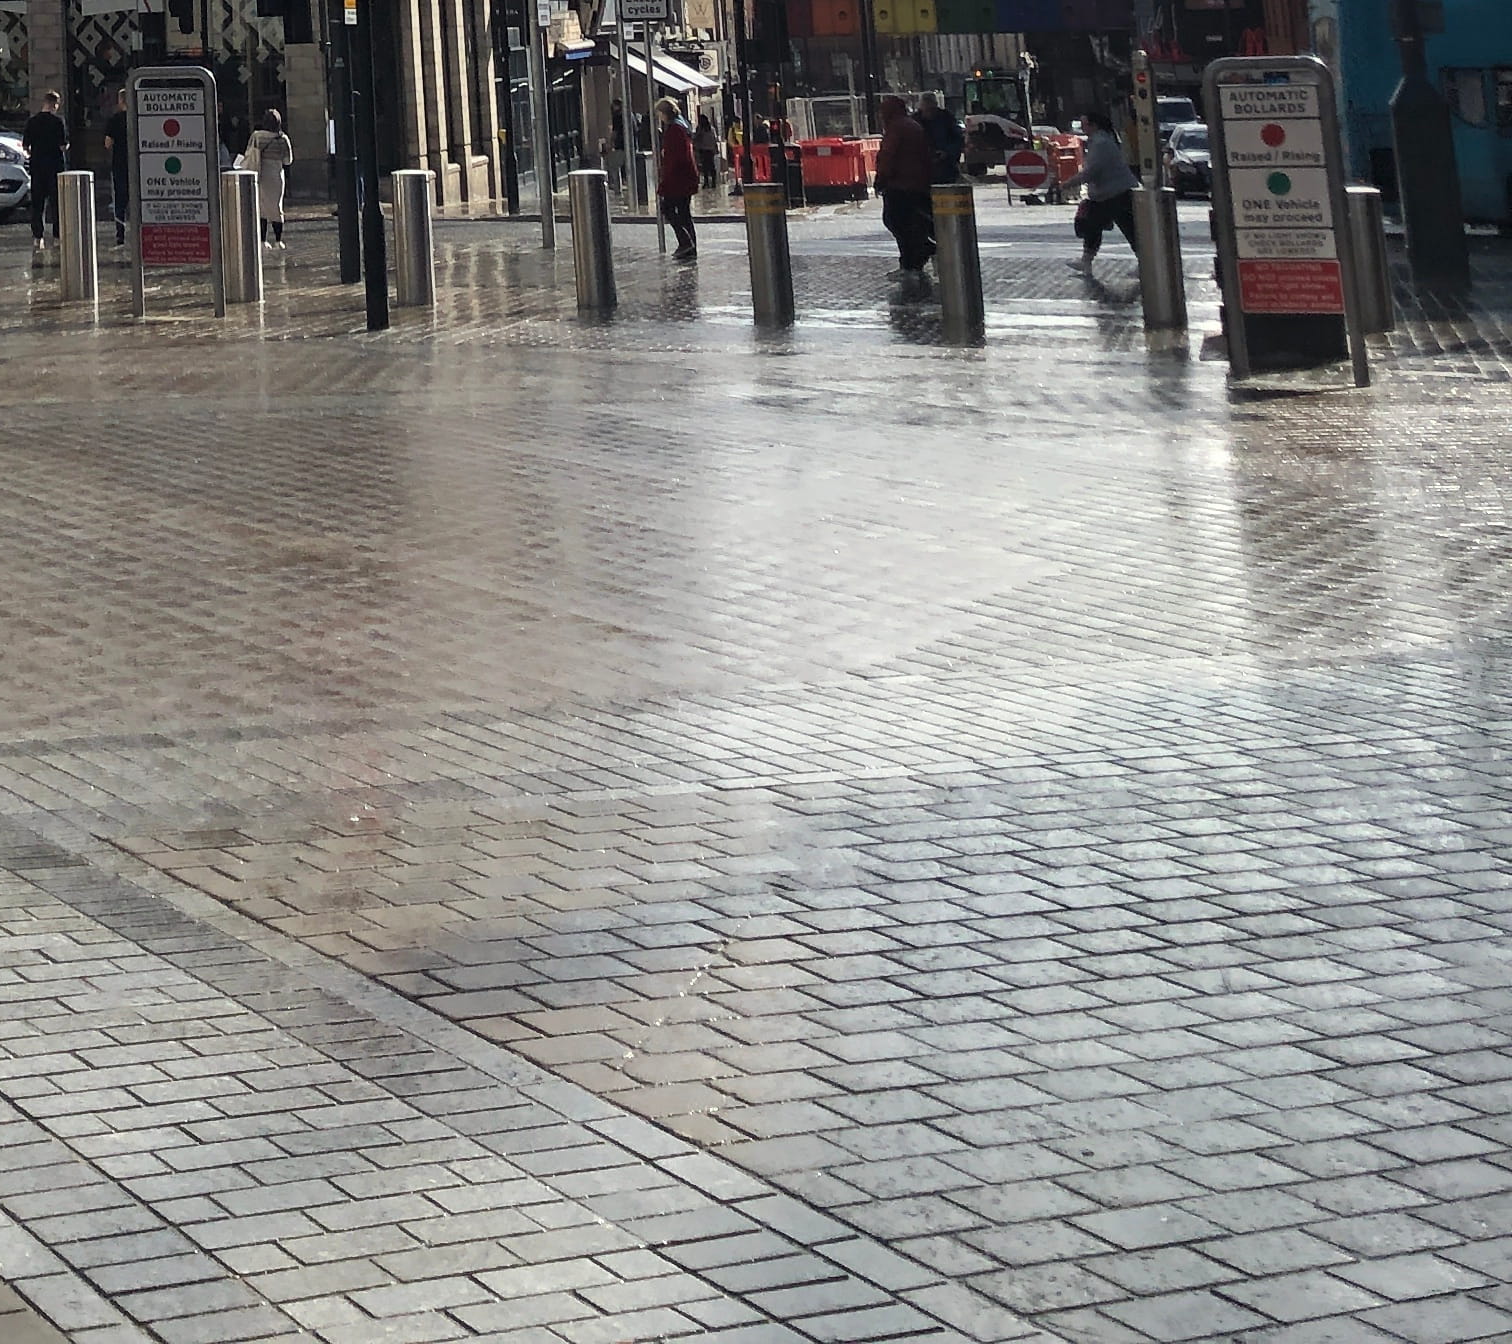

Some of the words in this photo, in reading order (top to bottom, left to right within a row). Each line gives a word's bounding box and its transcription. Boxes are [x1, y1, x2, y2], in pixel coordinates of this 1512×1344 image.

[628, 5, 661, 16] cycles
[143, 93, 197, 102] AUTOMATIC
[1229, 90, 1309, 102] AUTOMATIC
[146, 103, 195, 112] BOLLARDS
[1234, 102, 1306, 114] BOLLARDS
[141, 140, 170, 149] Raised
[177, 140, 203, 149] Rising
[1230, 152, 1272, 162] Raised
[1282, 151, 1321, 162] Rising
[146, 178, 166, 186] ONE
[170, 177, 200, 186] Vehicle
[148, 189, 164, 197] may
[168, 188, 201, 197] proceed
[1242, 200, 1271, 210] ONE
[1275, 200, 1321, 210] Vehicle
[1244, 215, 1269, 223] may
[1273, 213, 1323, 223] proceed
